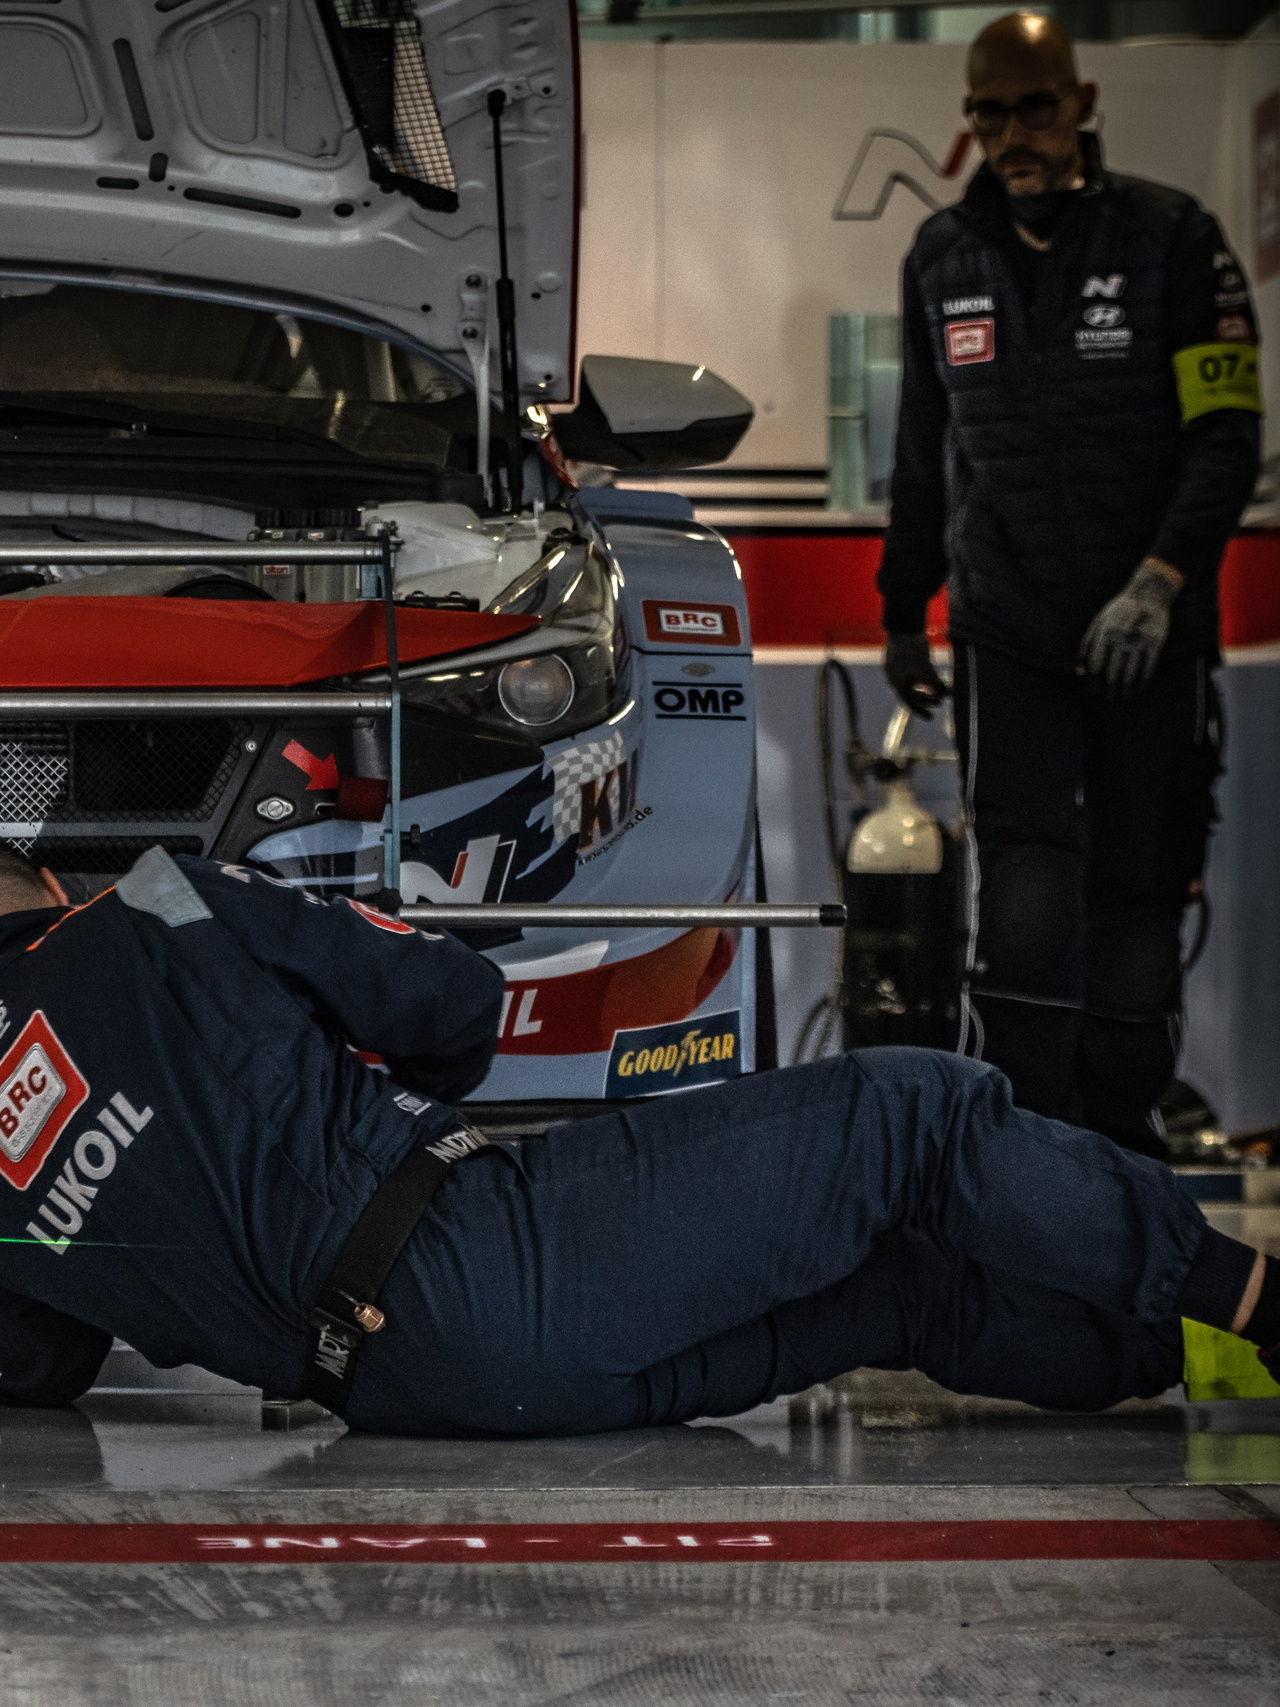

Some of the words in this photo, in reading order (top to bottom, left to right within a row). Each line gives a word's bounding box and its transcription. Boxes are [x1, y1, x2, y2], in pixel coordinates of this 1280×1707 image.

[665, 613, 718, 627] BRC
[654, 688, 744, 713] OMP
[617, 1030, 735, 1078] GOODYEAR
[25, 1091, 154, 1256] LUKOIL
